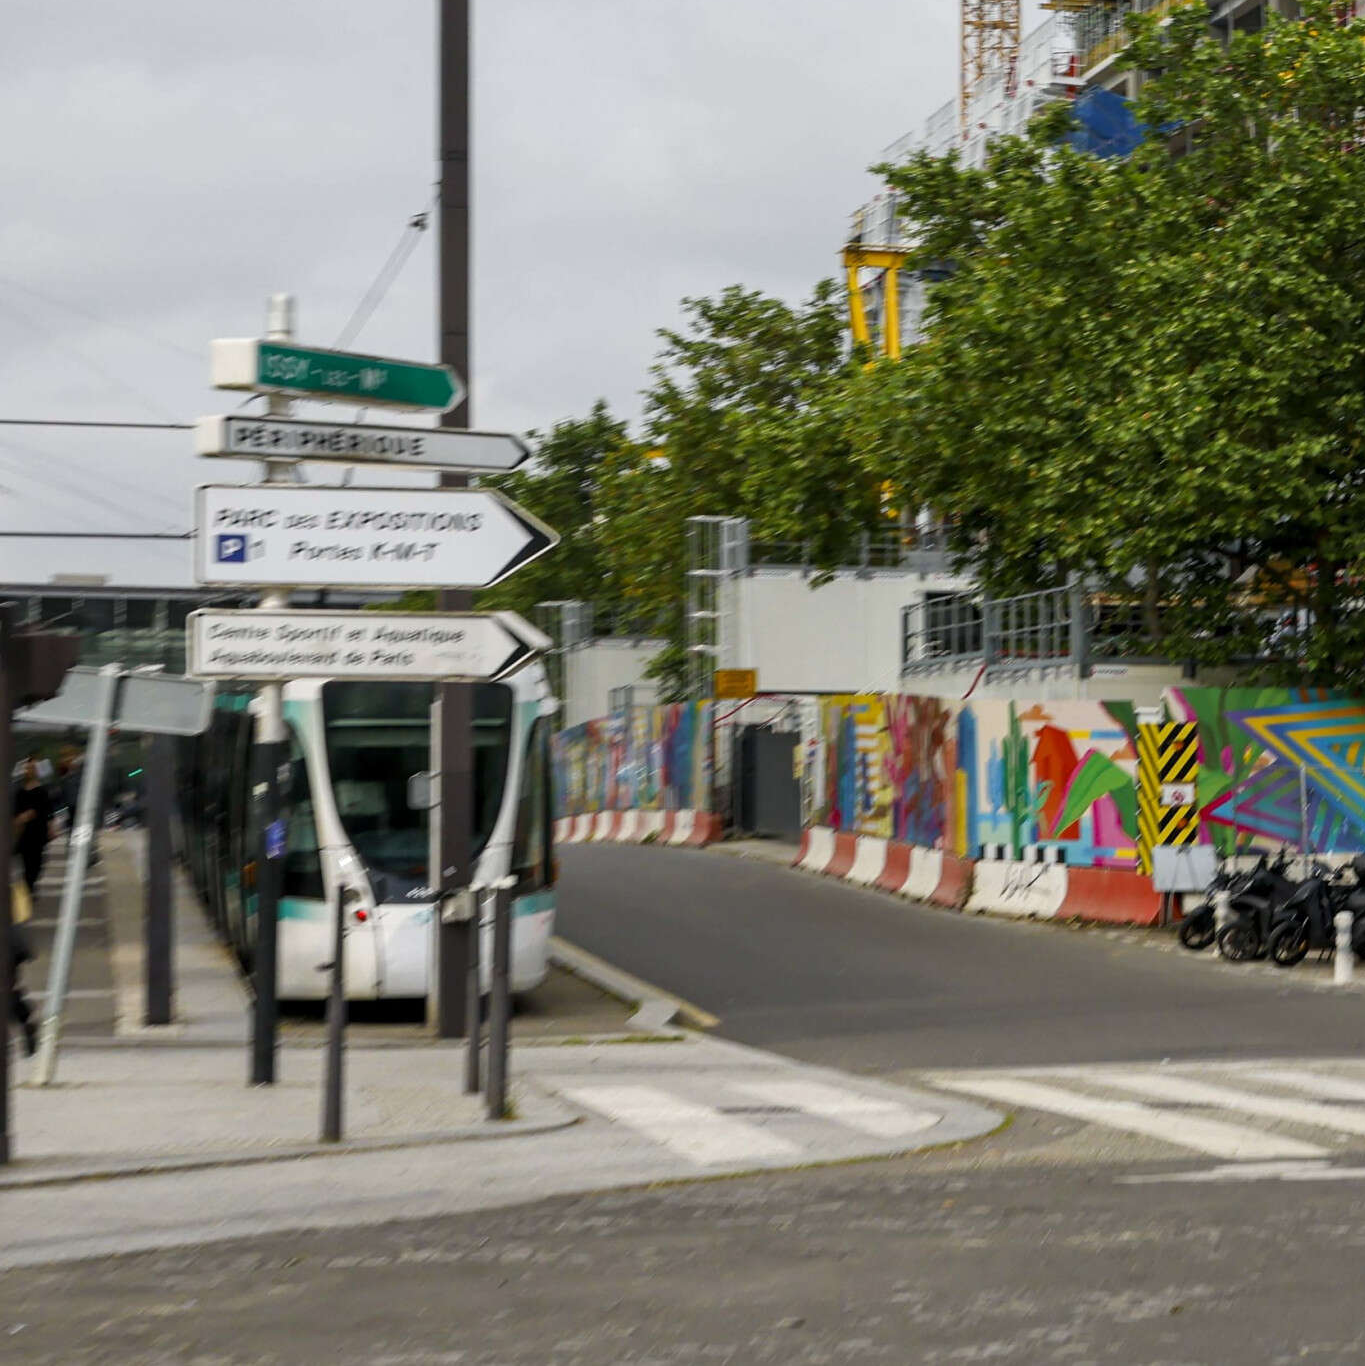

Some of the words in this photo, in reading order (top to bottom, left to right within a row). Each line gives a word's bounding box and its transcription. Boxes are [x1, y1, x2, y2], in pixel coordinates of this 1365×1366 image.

[234, 425, 426, 457] PÉRIPHÉRIQUE
[214, 507, 280, 530] PARC
[325, 509, 485, 532] EXPOSITIONS
[289, 541, 364, 562] Portes
[208, 622, 272, 641] Centre
[275, 623, 344, 642] Sportif
[347, 626, 363, 640] et
[373, 624, 465, 644] Aquatique
[208, 647, 339, 667] Aquaboulevard
[346, 649, 364, 665] de
[369, 649, 415, 666] Paris
